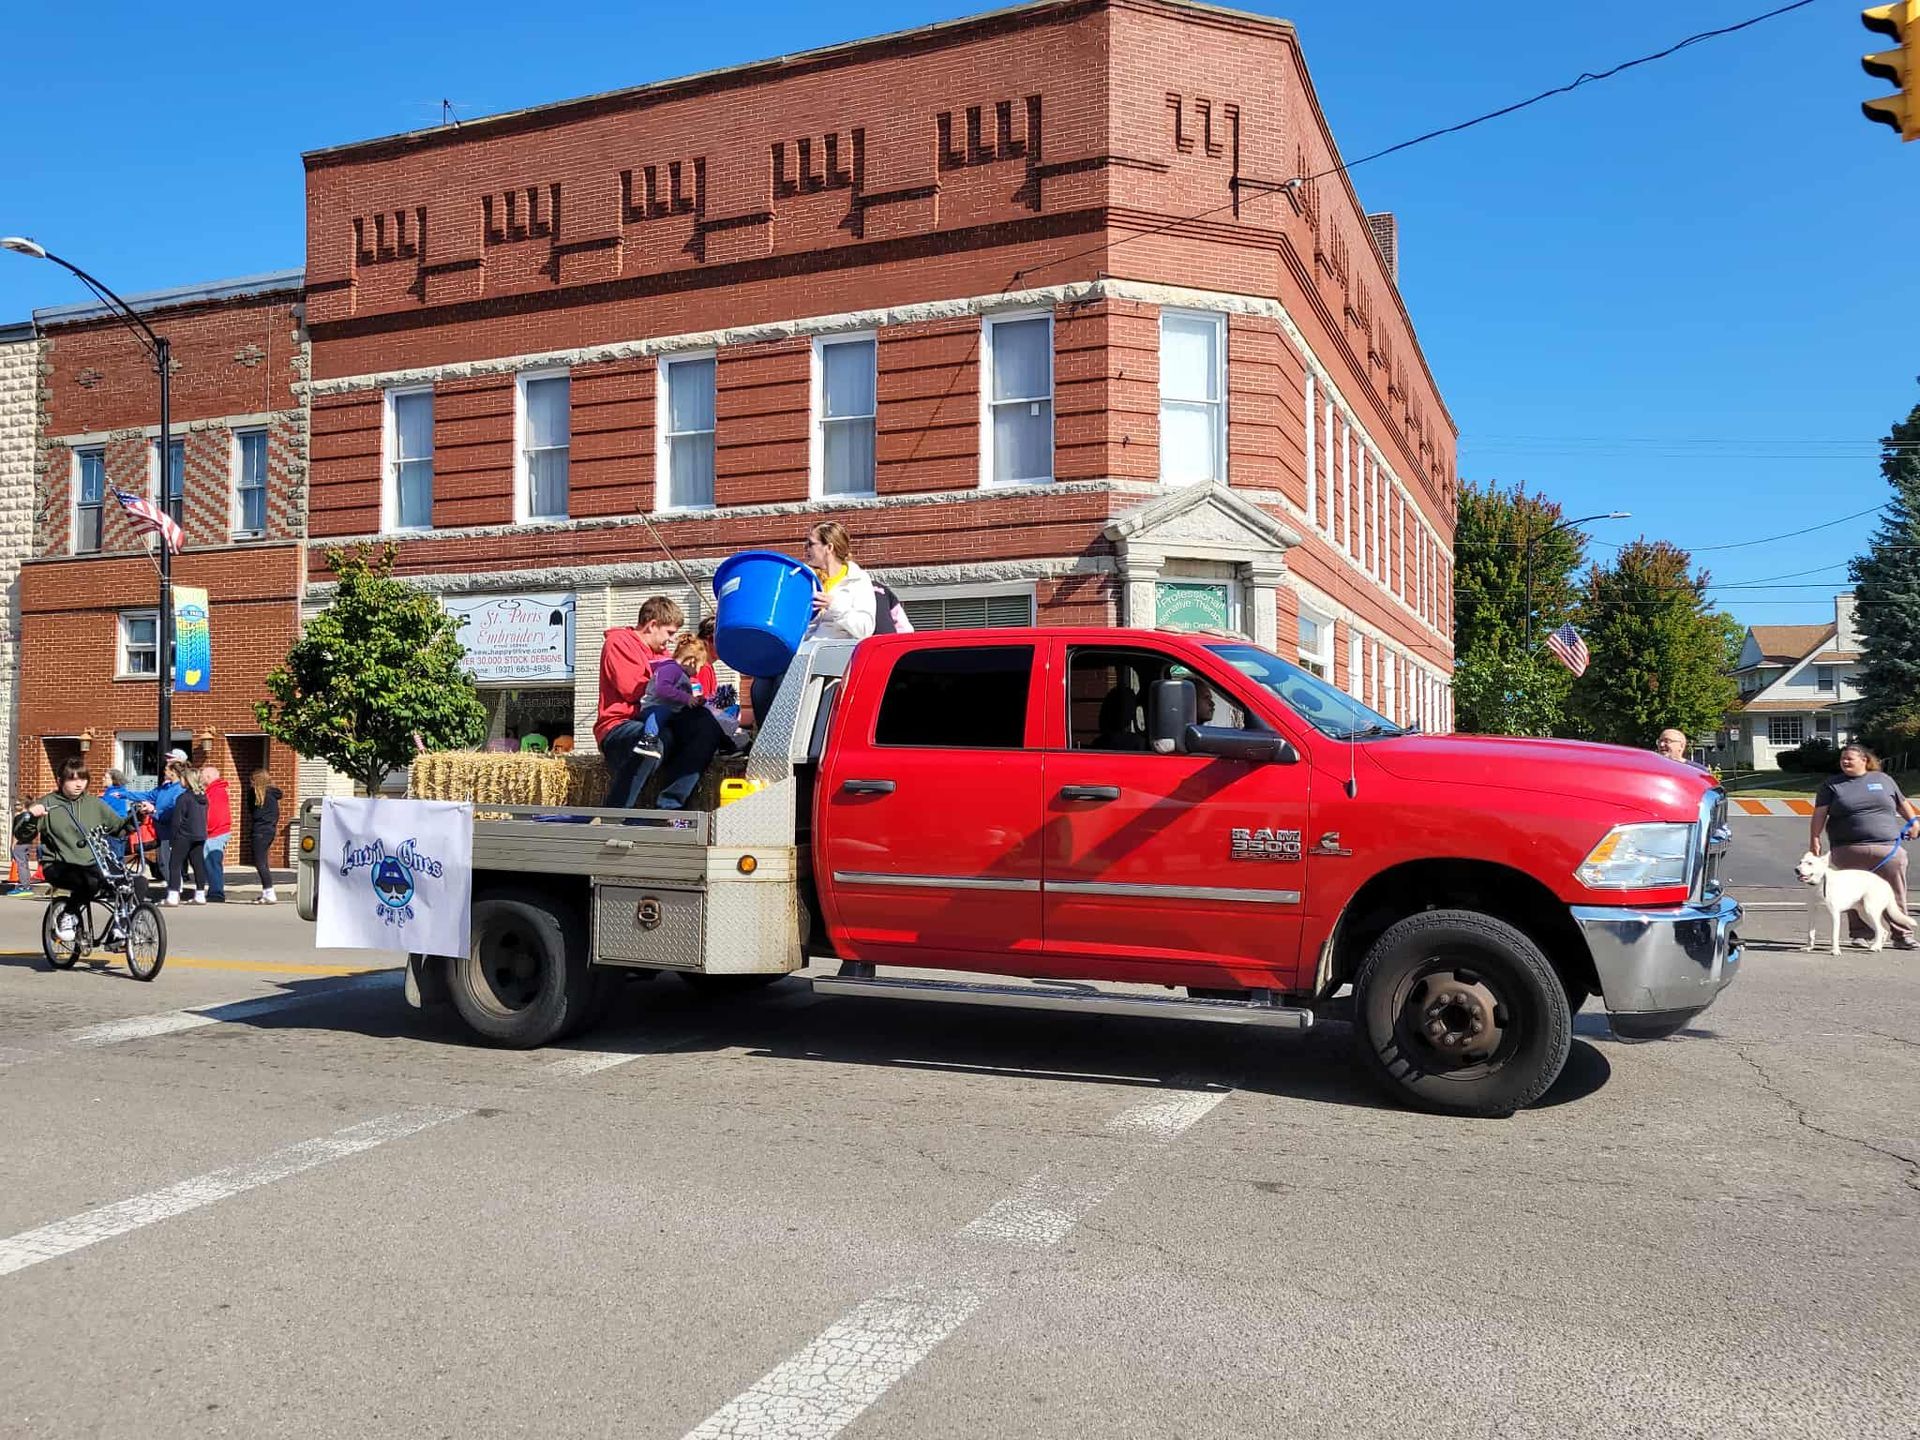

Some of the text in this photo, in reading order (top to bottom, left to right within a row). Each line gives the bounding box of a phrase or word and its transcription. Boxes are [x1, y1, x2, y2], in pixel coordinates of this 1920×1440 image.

[480, 607, 544, 629] St. Paris
[477, 627, 546, 645] Embroidery
[461, 657, 475, 666] VER
[504, 655, 528, 664] STOCK
[530, 654, 562, 663] DESIGNS
[495, 665, 513, 674] (937)
[1232, 828, 1300, 841] RAM
[1232, 840, 1300, 853] 3500
[396, 838, 443, 879] Ones
